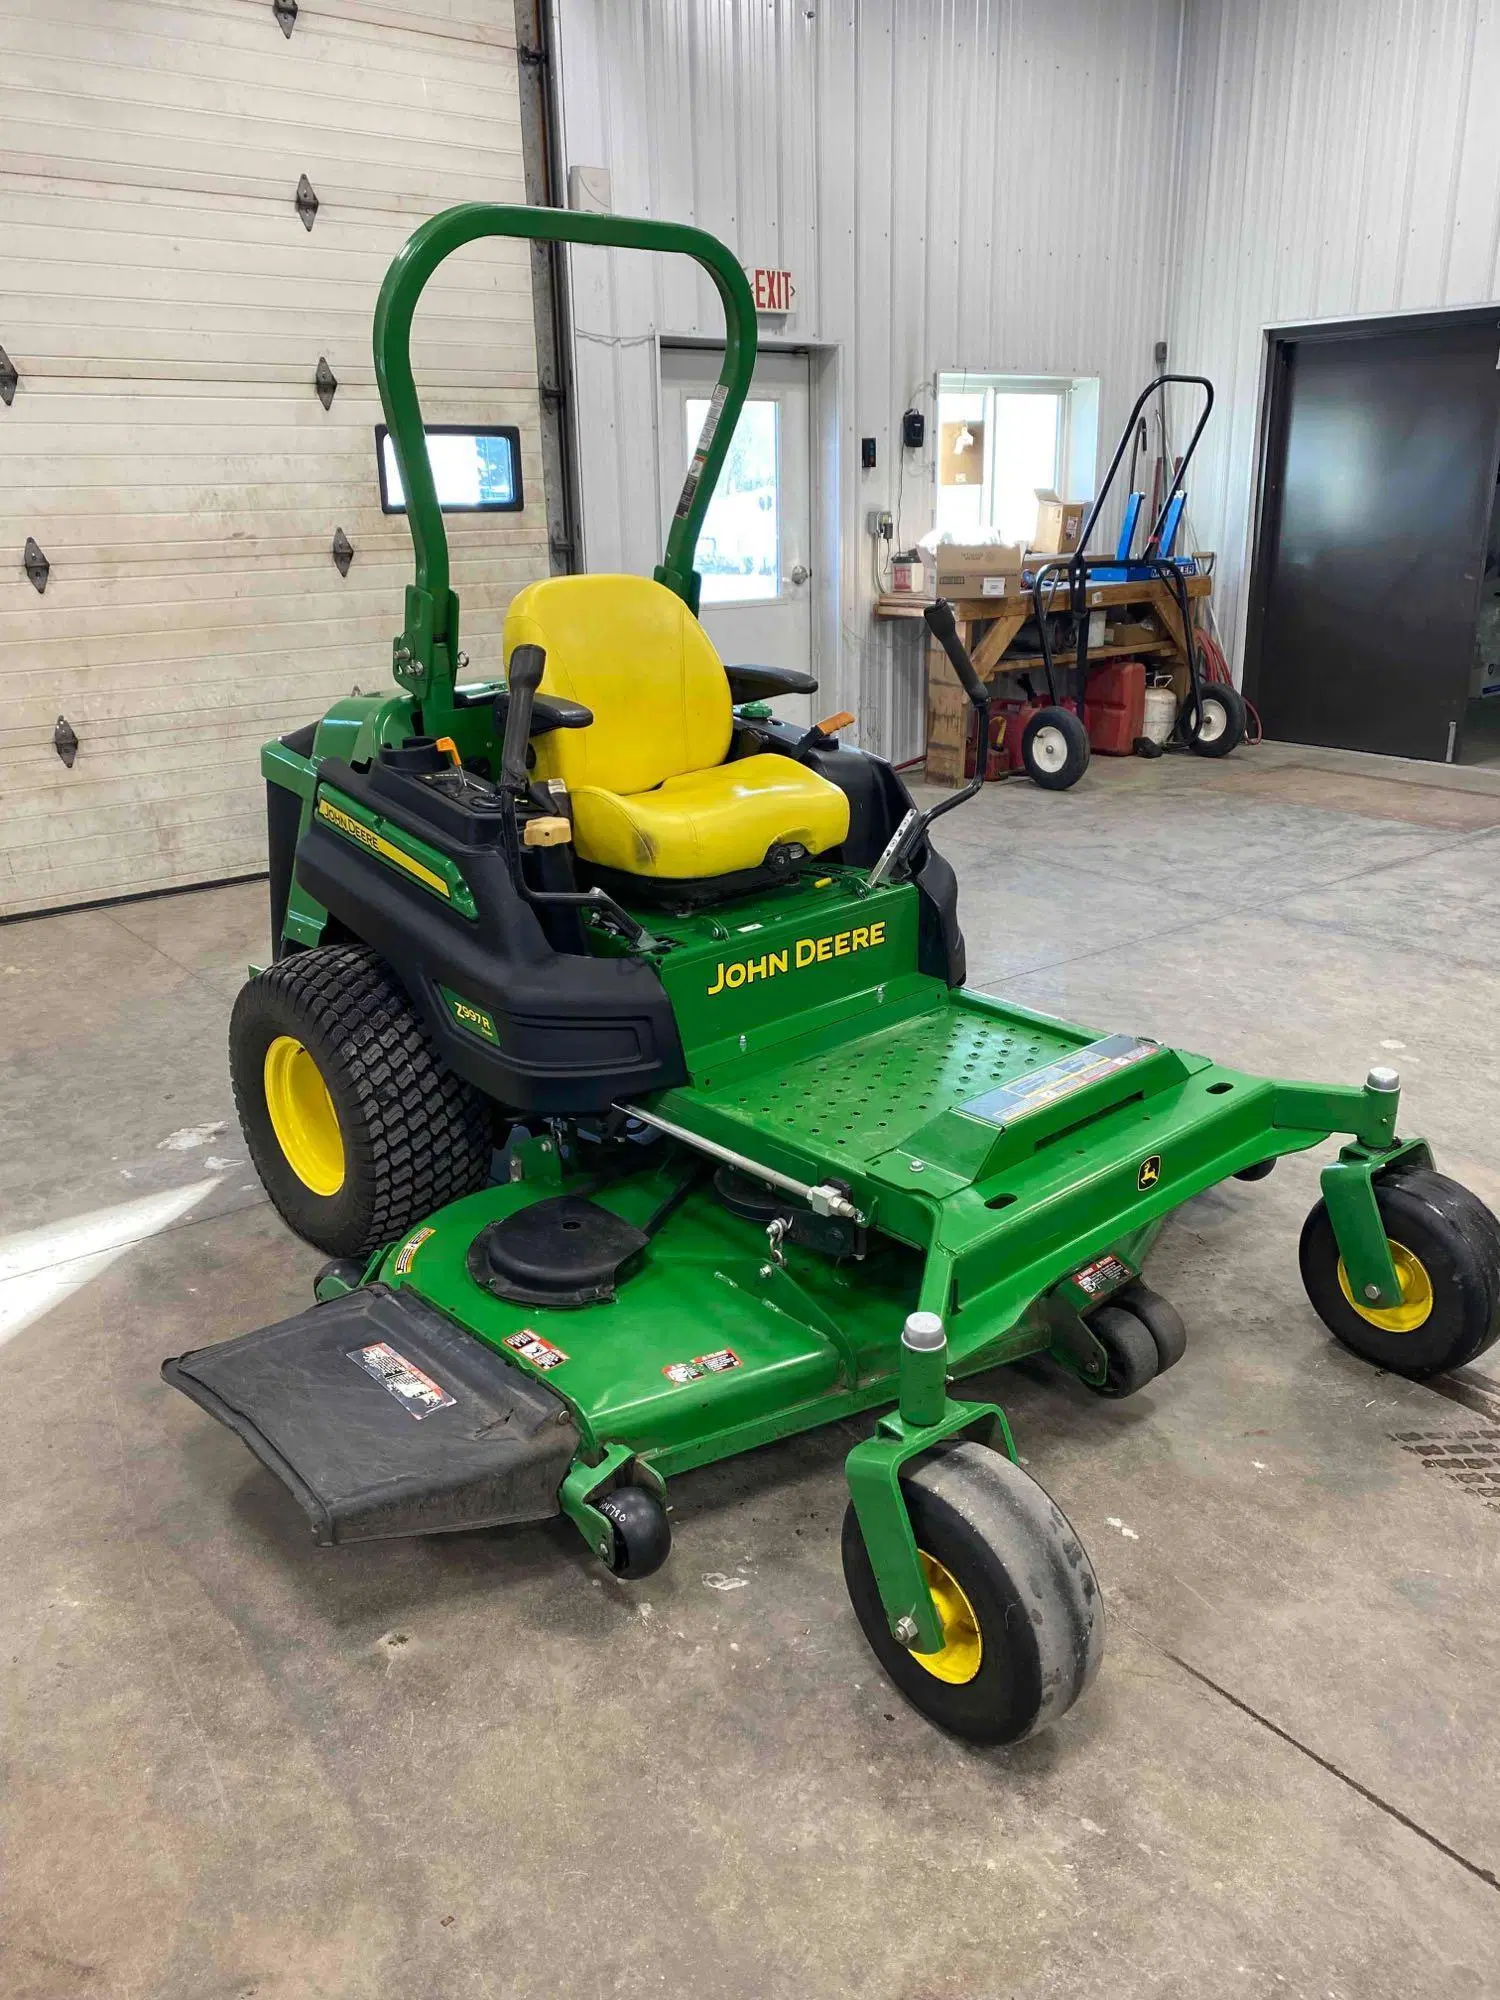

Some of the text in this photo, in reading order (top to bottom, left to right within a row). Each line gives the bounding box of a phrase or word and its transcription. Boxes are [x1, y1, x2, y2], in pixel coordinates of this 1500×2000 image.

[755, 269, 792, 310] EXIT
[323, 803, 380, 851] JOHN DEERE
[707, 920, 887, 996] JOHN DEERE
